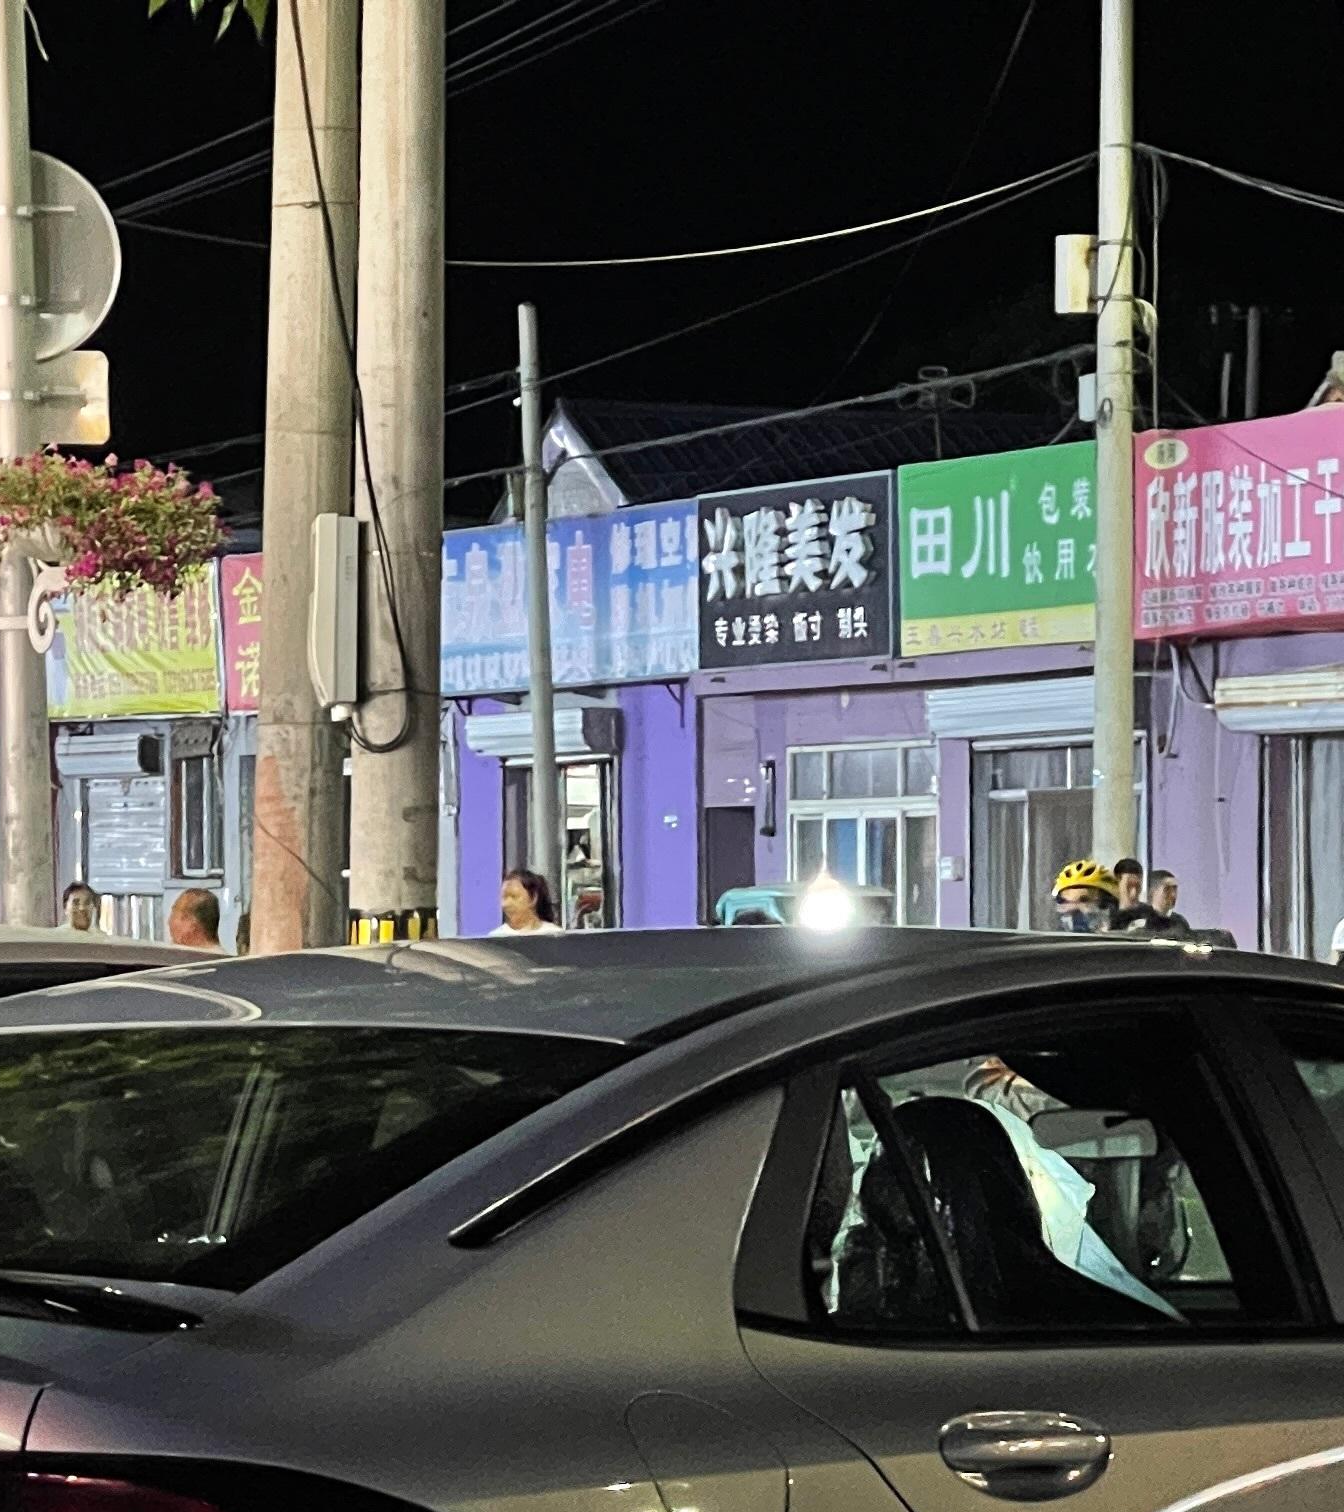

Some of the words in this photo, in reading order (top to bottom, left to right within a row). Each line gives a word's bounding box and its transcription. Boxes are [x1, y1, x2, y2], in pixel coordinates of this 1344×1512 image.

[910, 489, 1010, 579] 田川
[1038, 477, 1092, 525] 包装
[702, 497, 877, 602] 兴隆美发
